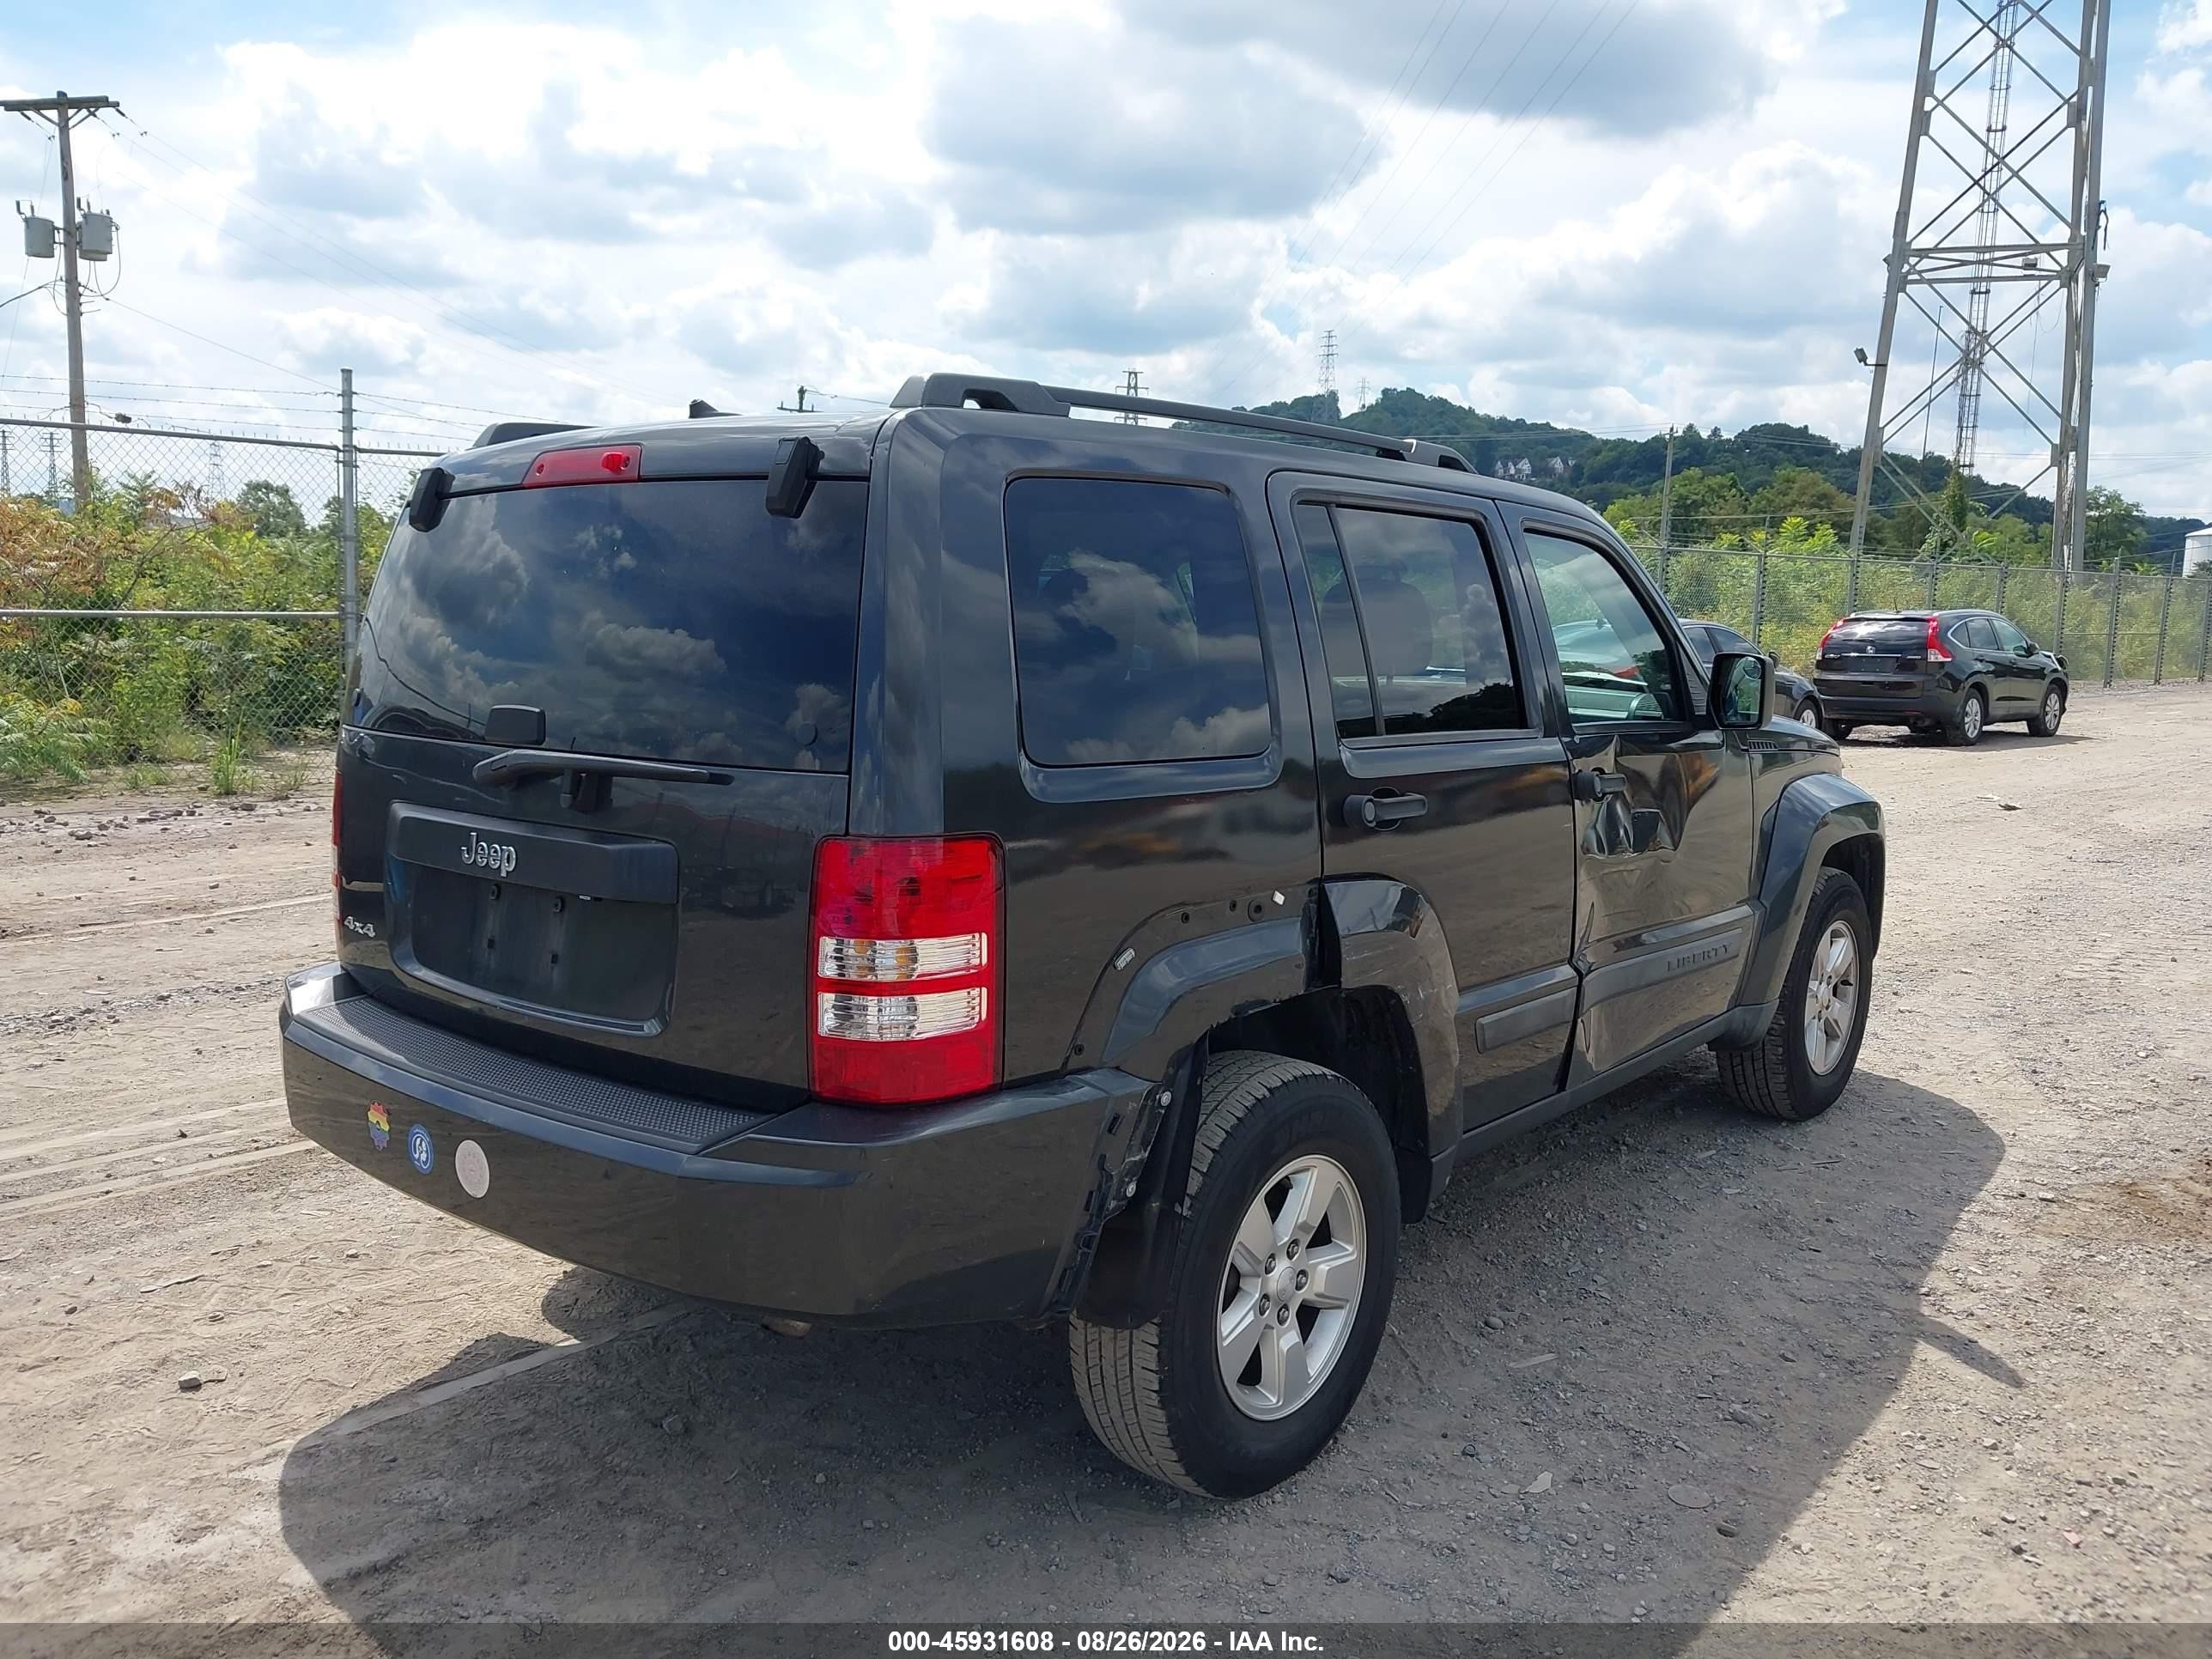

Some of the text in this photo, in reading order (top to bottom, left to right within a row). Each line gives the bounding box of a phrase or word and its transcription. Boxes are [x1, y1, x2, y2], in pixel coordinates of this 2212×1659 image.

[460, 832, 516, 877] Jeep
[343, 915, 376, 938] 4x4
[1668, 944, 1729, 971] LIBERTY
